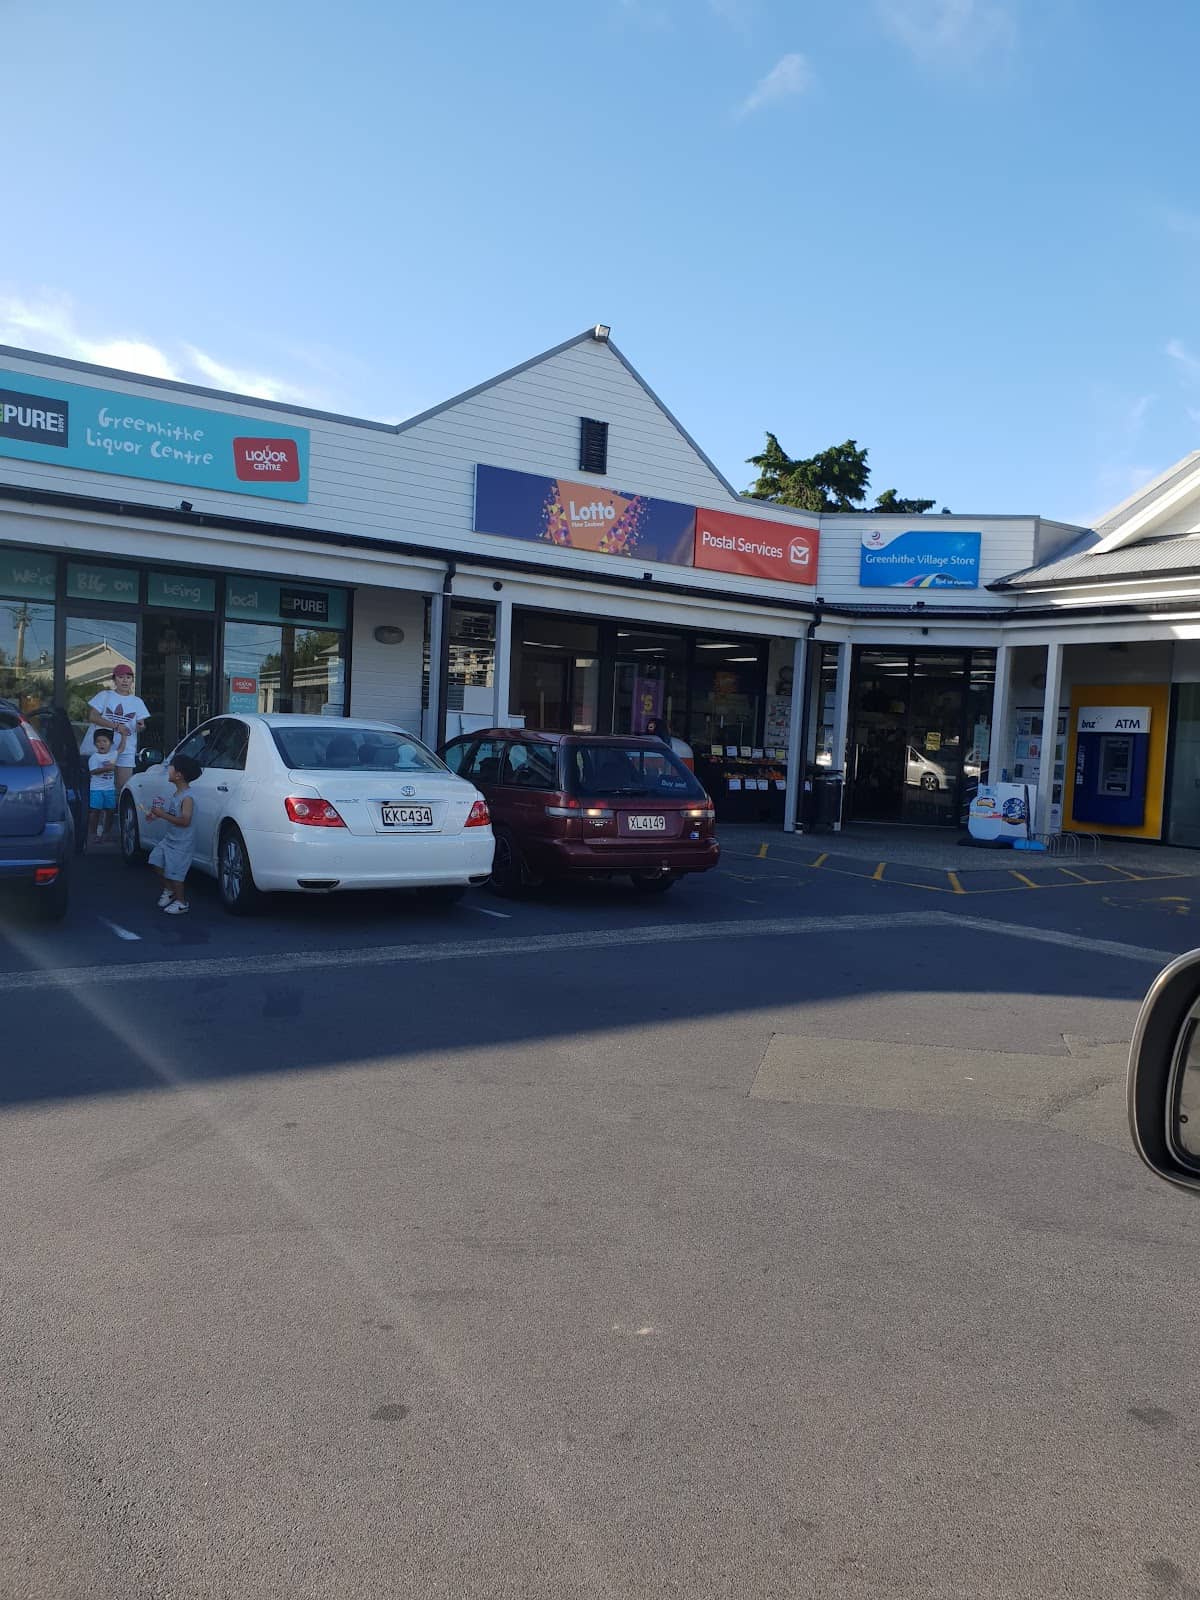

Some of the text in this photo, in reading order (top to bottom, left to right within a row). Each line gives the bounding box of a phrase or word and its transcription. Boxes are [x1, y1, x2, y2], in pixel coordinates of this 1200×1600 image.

[4, 403, 58, 432] PURE
[98, 407, 205, 442] Greenhithe
[86, 428, 214, 465] Liquor Centre
[245, 446, 288, 463] LIQUOR
[253, 463, 282, 472] CENTRE
[569, 501, 616, 521] Lotto
[702, 531, 783, 559] Postal Services
[865, 554, 975, 568] Greenhithe Village Store
[113, 580, 133, 592] on
[163, 583, 201, 602] being
[229, 589, 258, 609] local
[293, 598, 323, 613] PURE
[1081, 719, 1096, 729] bnz
[1114, 719, 1140, 729] ATM
[384, 810, 430, 822] KKC434
[629, 817, 664, 829] XL4149
